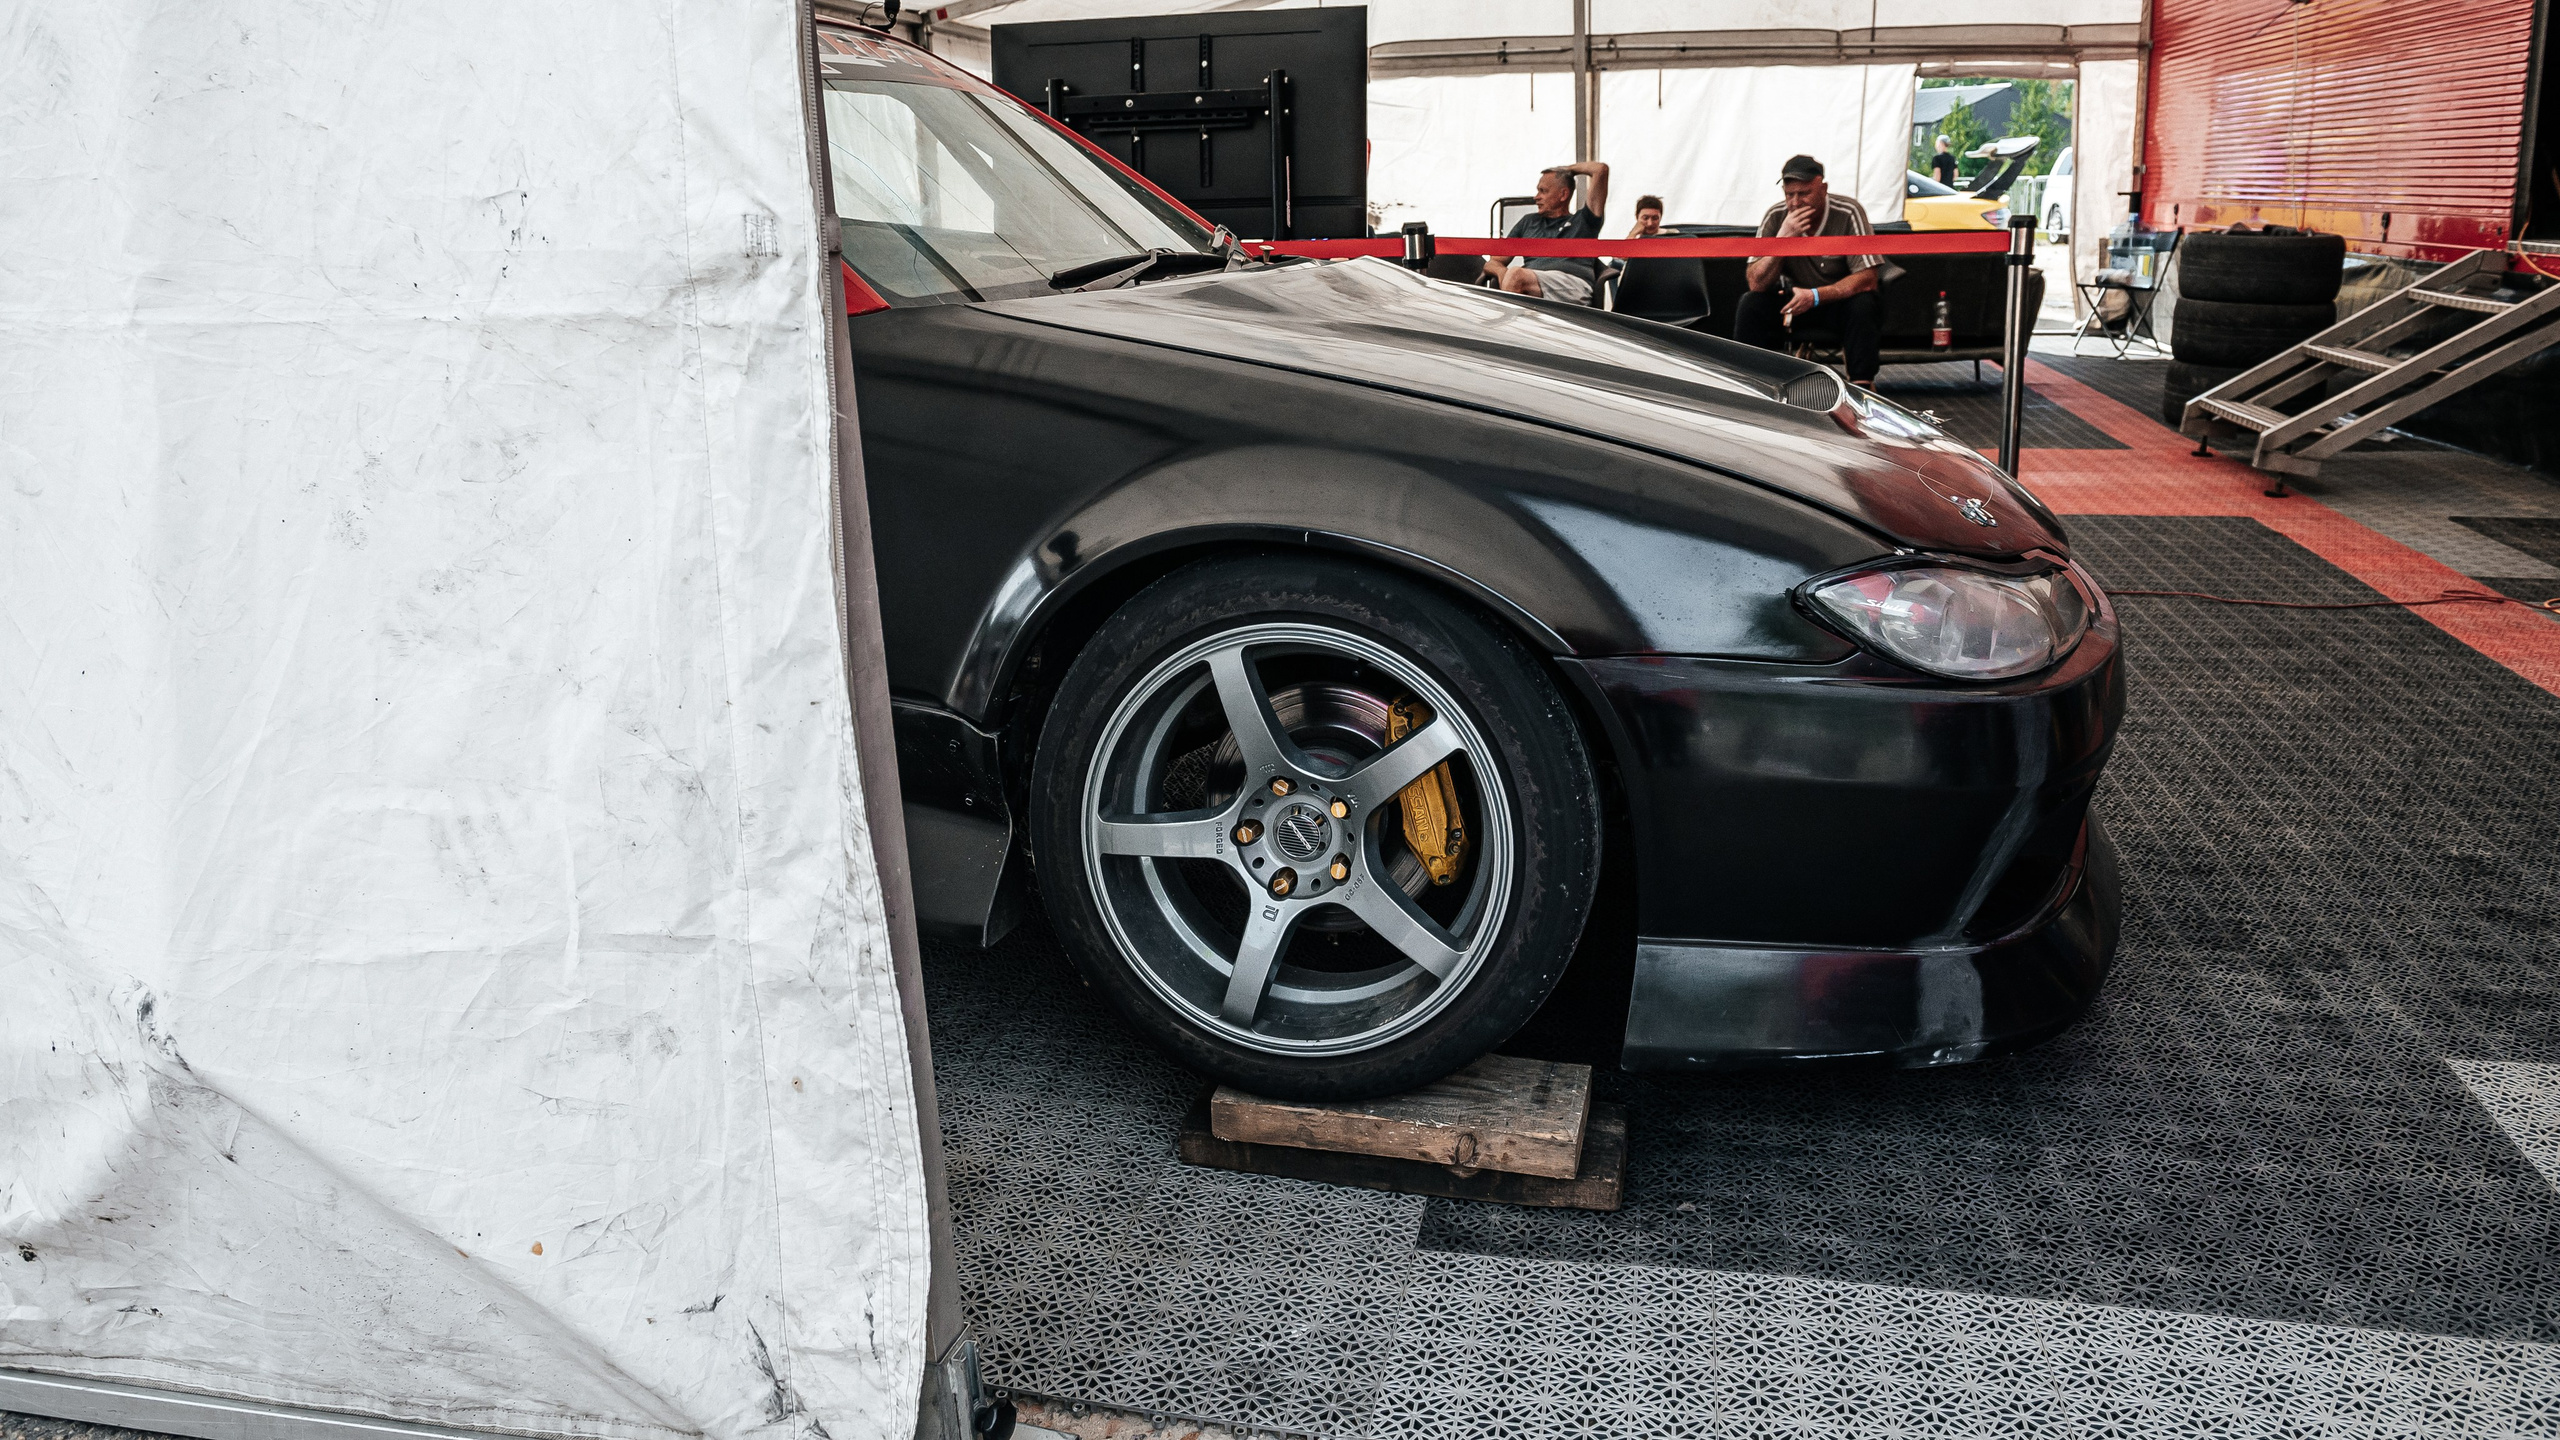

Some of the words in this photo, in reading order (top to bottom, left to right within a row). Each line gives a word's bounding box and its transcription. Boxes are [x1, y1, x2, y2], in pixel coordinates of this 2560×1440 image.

[817, 29, 924, 69] RIFT
[1407, 784, 1430, 832] SSAN
[1214, 821, 1224, 855] FORGED
